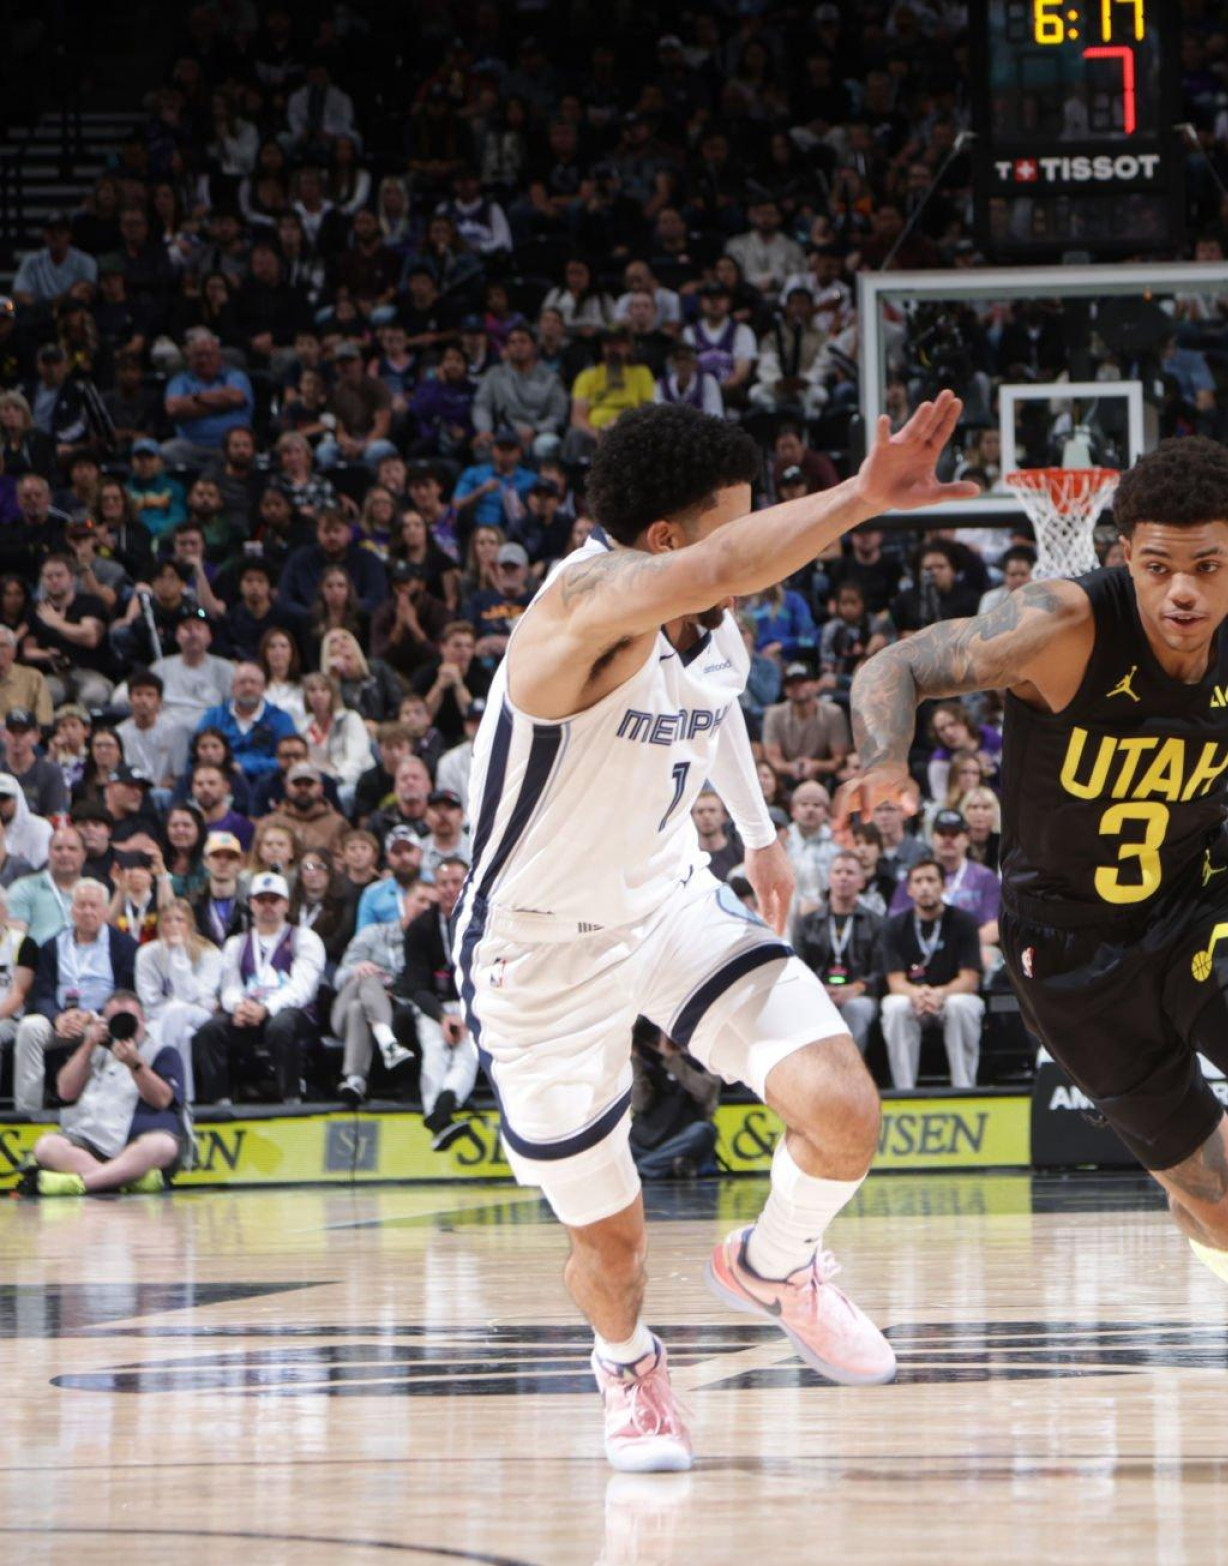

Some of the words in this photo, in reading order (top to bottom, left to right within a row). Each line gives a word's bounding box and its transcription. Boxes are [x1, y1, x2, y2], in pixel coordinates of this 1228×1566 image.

[1033, 0, 1145, 45] 6:17
[1082, 45, 1136, 135] 7
[1039, 155, 1160, 181] TISSOT
[658, 761, 691, 832] 1
[1094, 801, 1170, 904] 3
